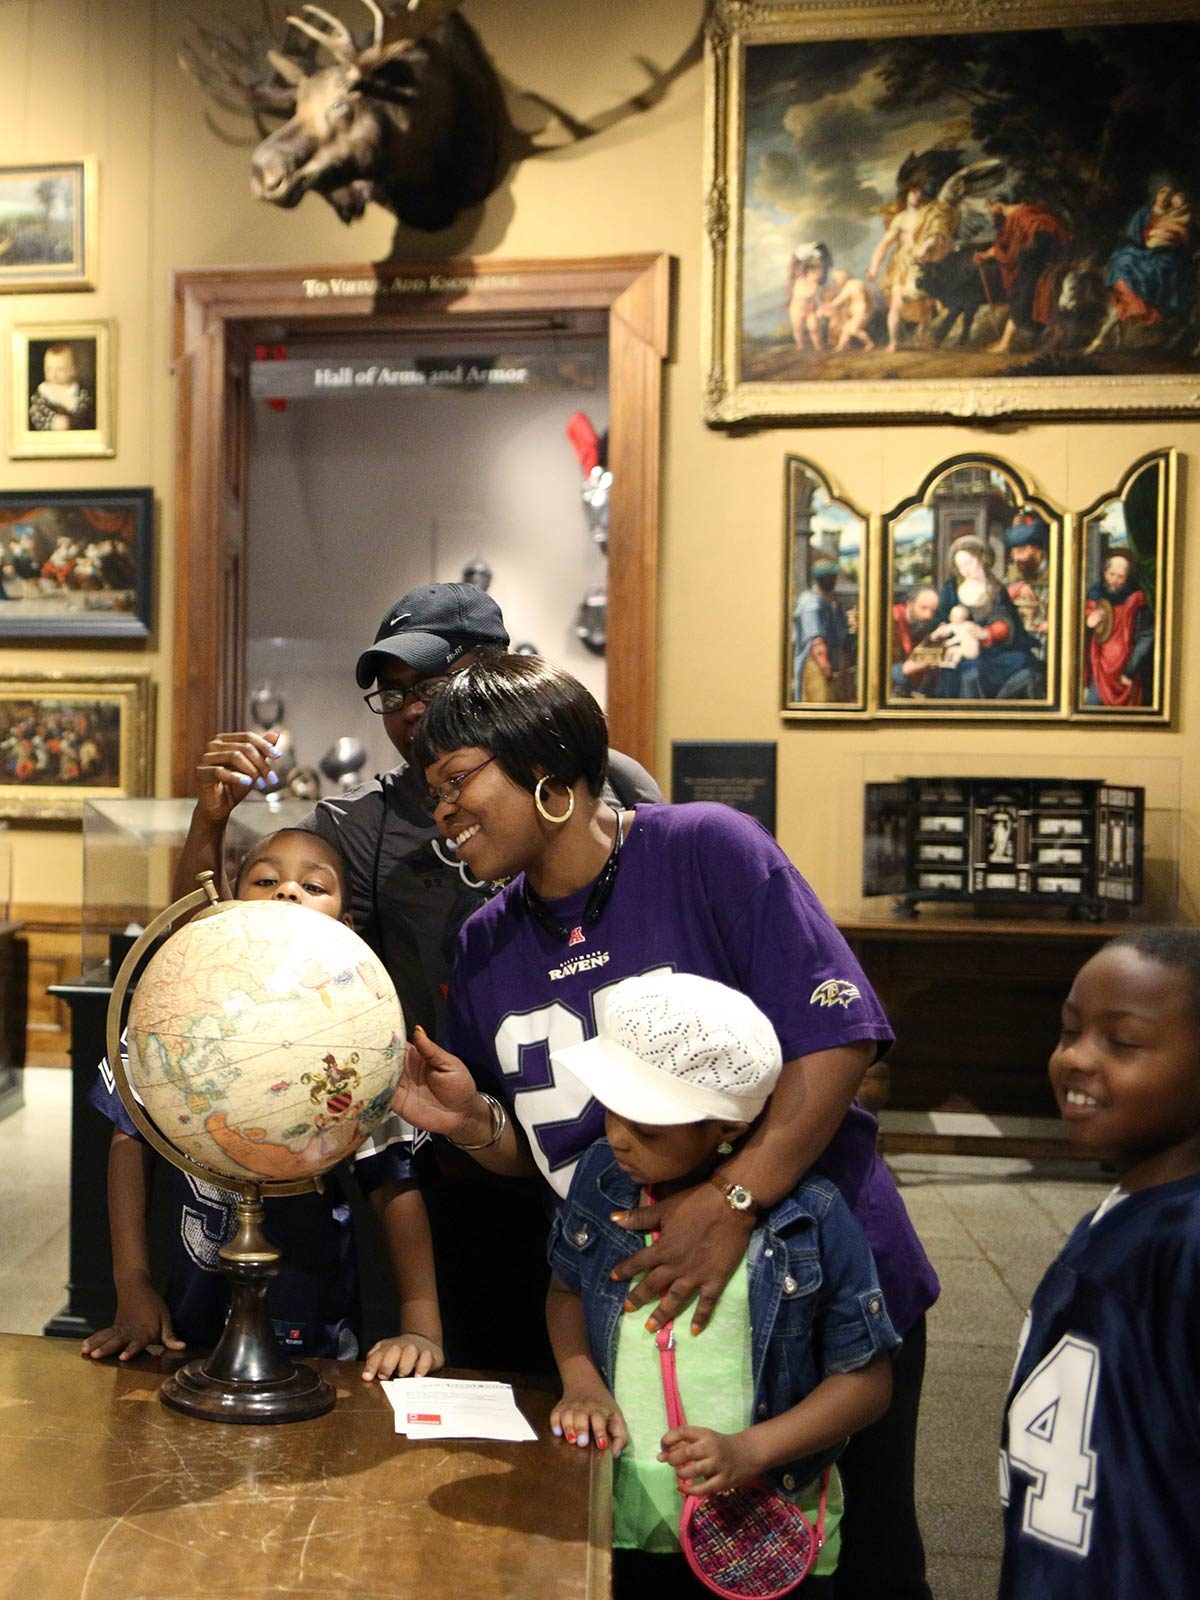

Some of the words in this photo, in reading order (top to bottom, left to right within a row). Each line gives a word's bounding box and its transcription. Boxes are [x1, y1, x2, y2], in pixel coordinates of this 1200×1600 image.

[314, 367, 352, 388] Hall
[354, 366, 378, 386] of
[377, 367, 427, 386] Arms
[428, 365, 463, 384] and
[464, 366, 528, 385] Armor
[548, 951, 610, 981] RAVENS
[999, 1333, 1100, 1557] 4
